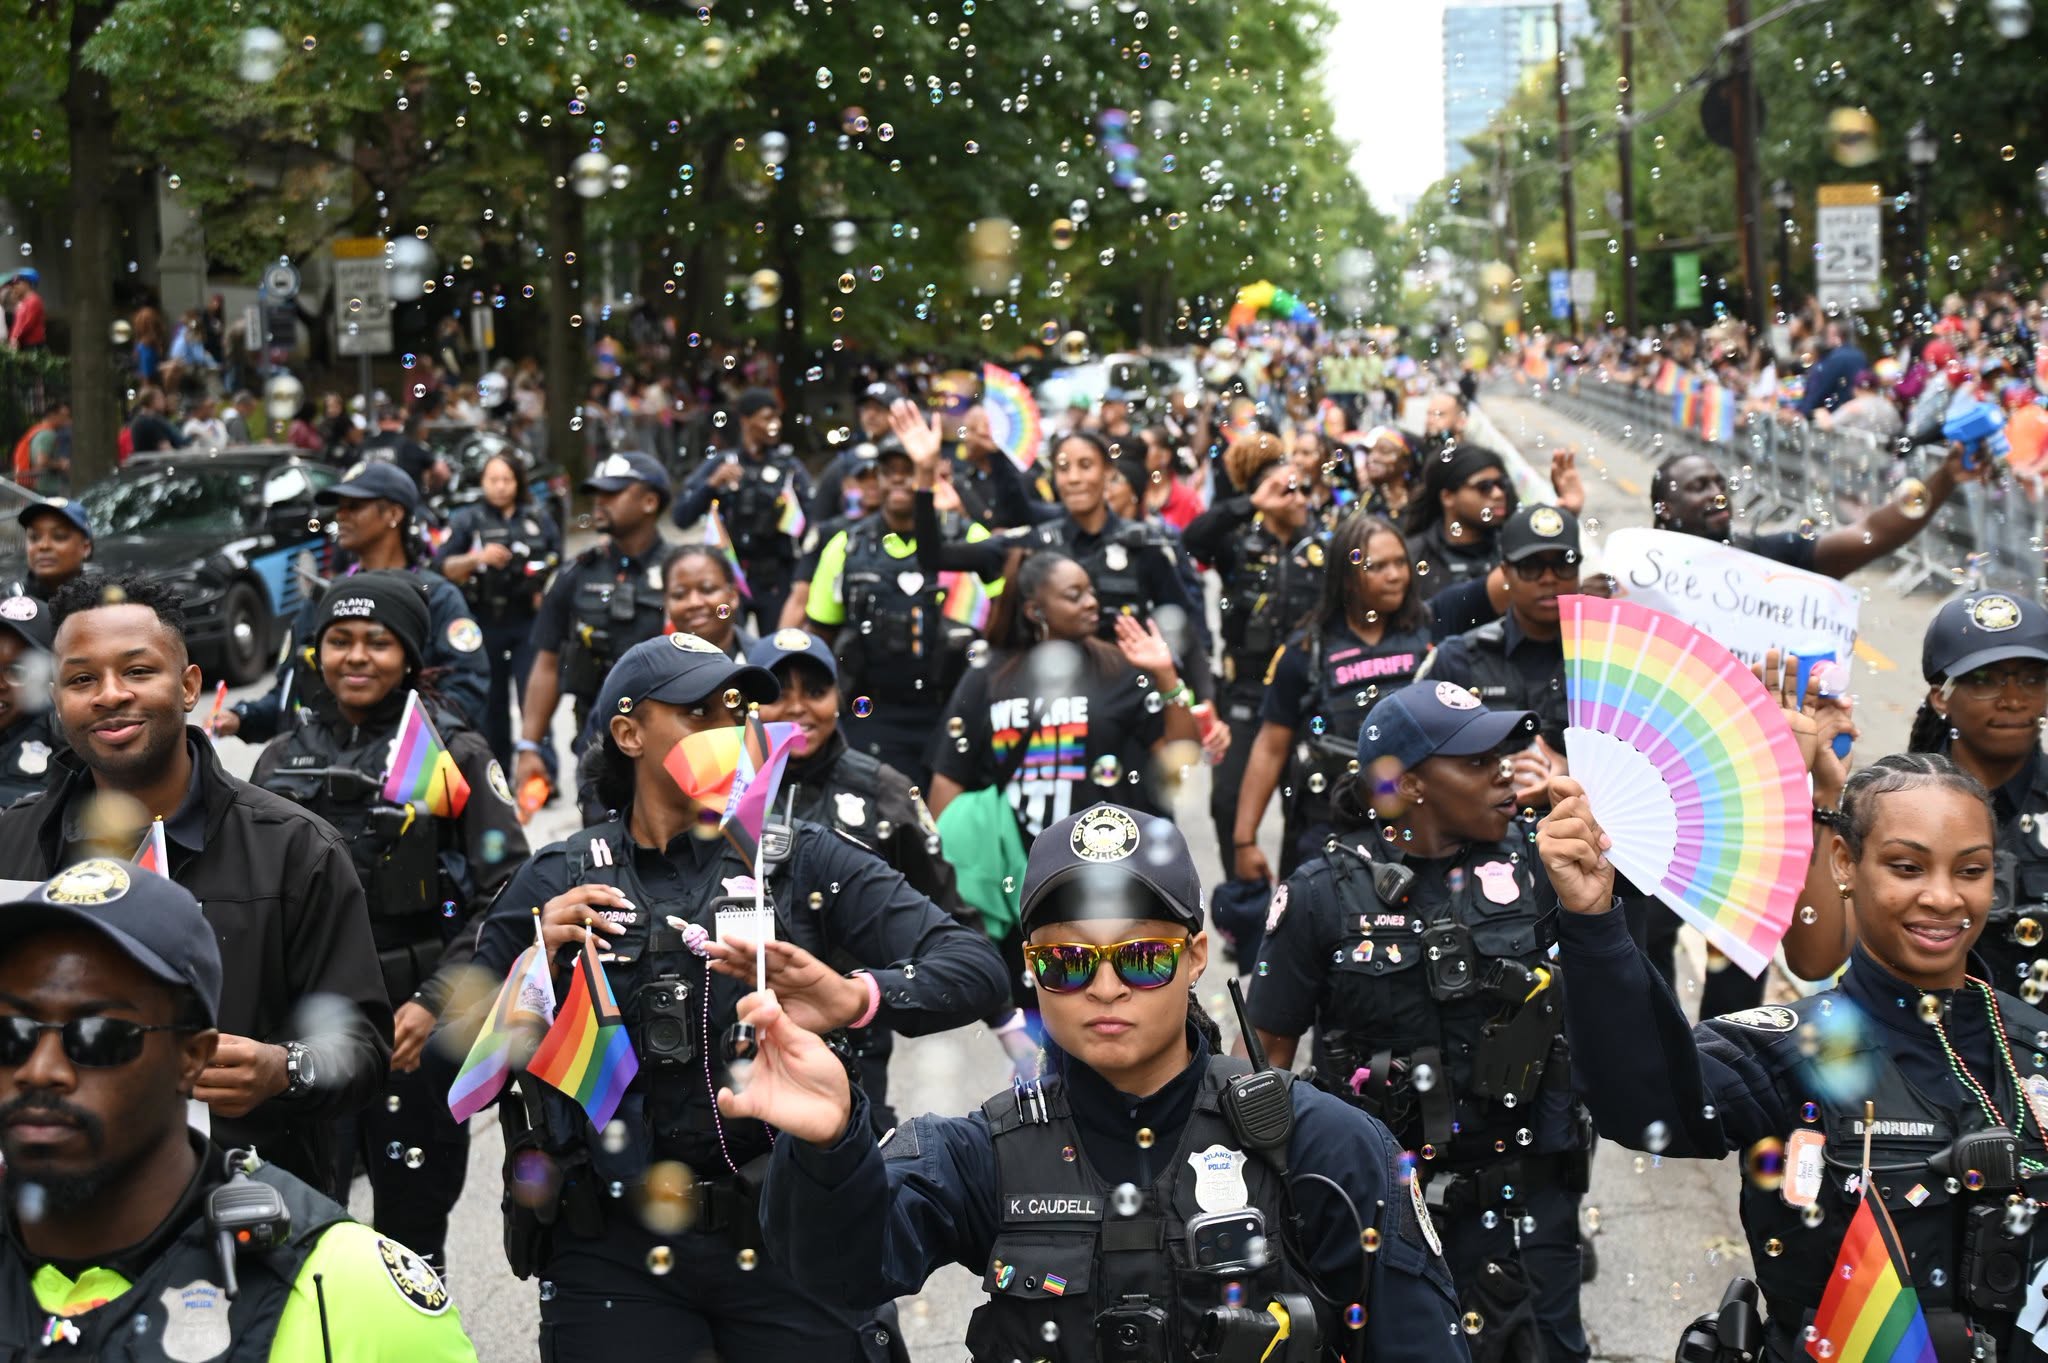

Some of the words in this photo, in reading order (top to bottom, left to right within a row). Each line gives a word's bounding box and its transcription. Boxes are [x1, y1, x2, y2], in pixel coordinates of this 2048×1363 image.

[1825, 245, 1874, 271] 25
[333, 597, 375, 609] ATLANTA
[333, 606, 371, 616] POLICE
[1630, 549, 1703, 598] See
[1712, 569, 1858, 657] Something
[1335, 653, 1414, 684] SHERIFF
[990, 697, 1029, 732] WE
[1085, 809, 1099, 823] OF
[1102, 808, 1137, 840] ATLANTA
[1080, 847, 1128, 860] POLICE
[1374, 914, 1405, 926] JONES
[1203, 1151, 1232, 1162] ATLANTA
[1208, 1162, 1231, 1171] POLICE
[1010, 1199, 1025, 1215] K.
[1028, 1199, 1096, 1215] CAUDELL
[425, 1290, 448, 1307] POL
